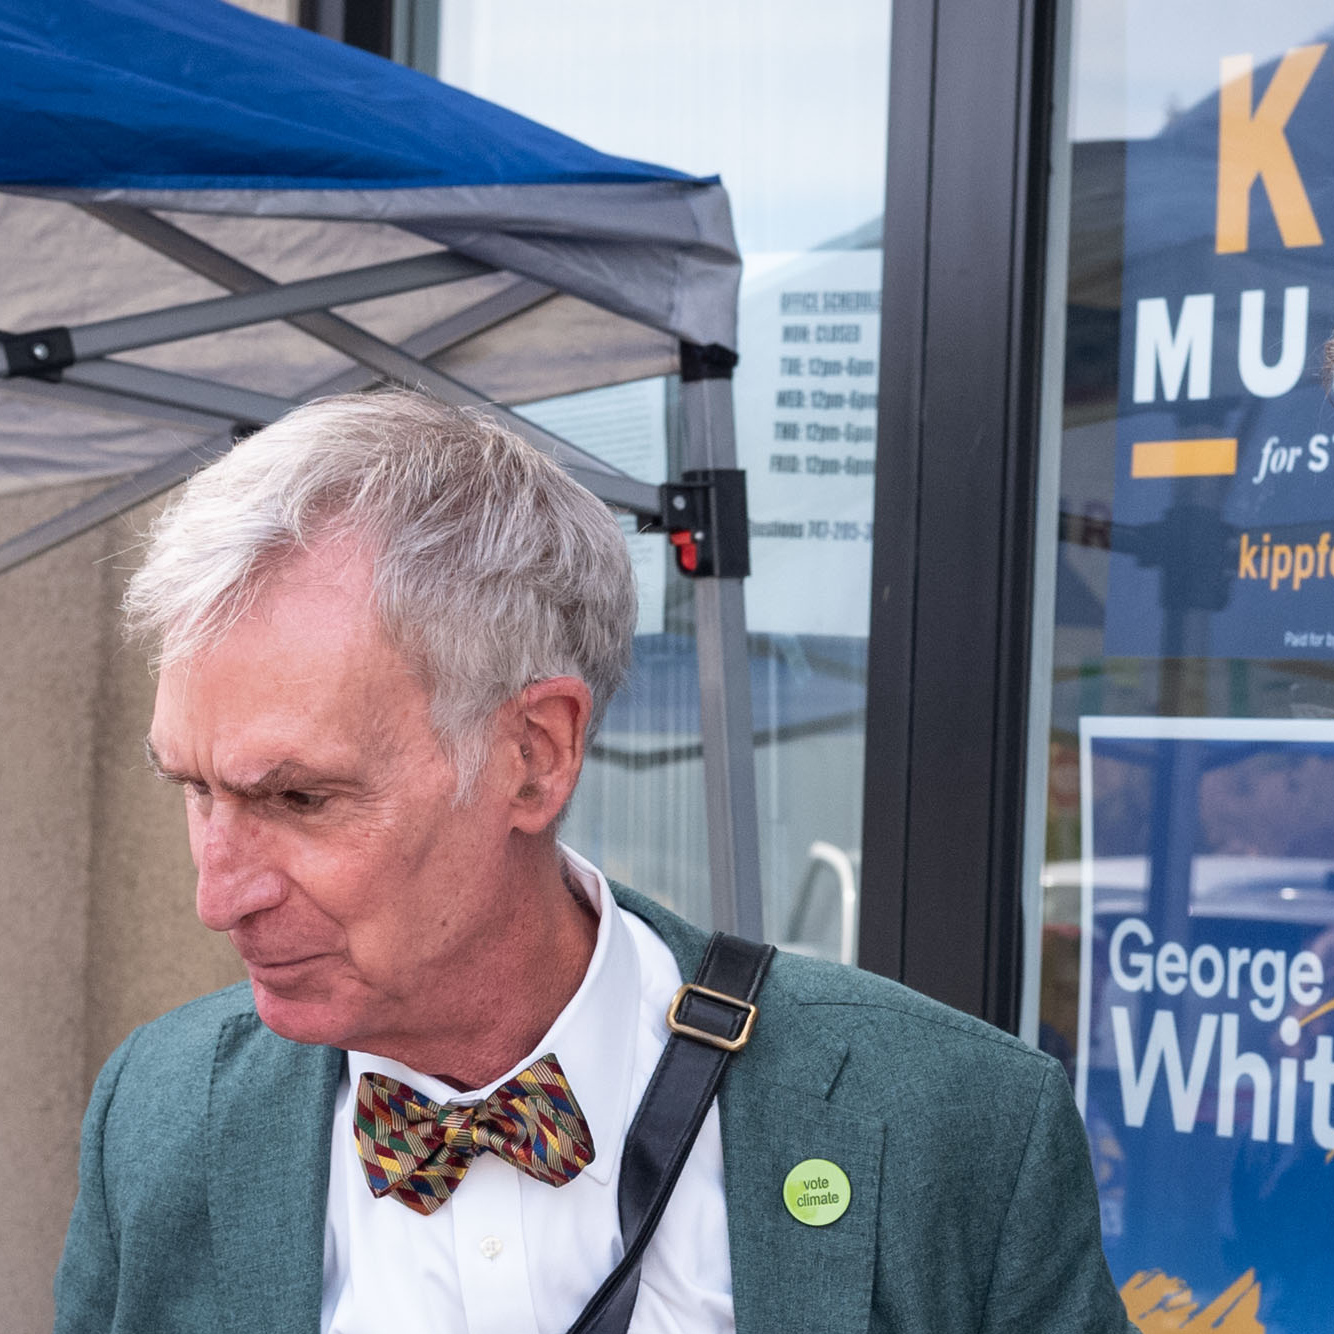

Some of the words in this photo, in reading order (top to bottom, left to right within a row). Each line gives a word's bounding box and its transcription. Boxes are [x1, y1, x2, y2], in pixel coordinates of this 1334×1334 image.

[814, 324, 861, 344] CLOSED
[1251, 435, 1303, 486] for
[1284, 630, 1308, 648] Paid
[1109, 918, 1324, 1022] George
[803, 1176, 829, 1190] vote
[796, 1191, 840, 1207] climate
